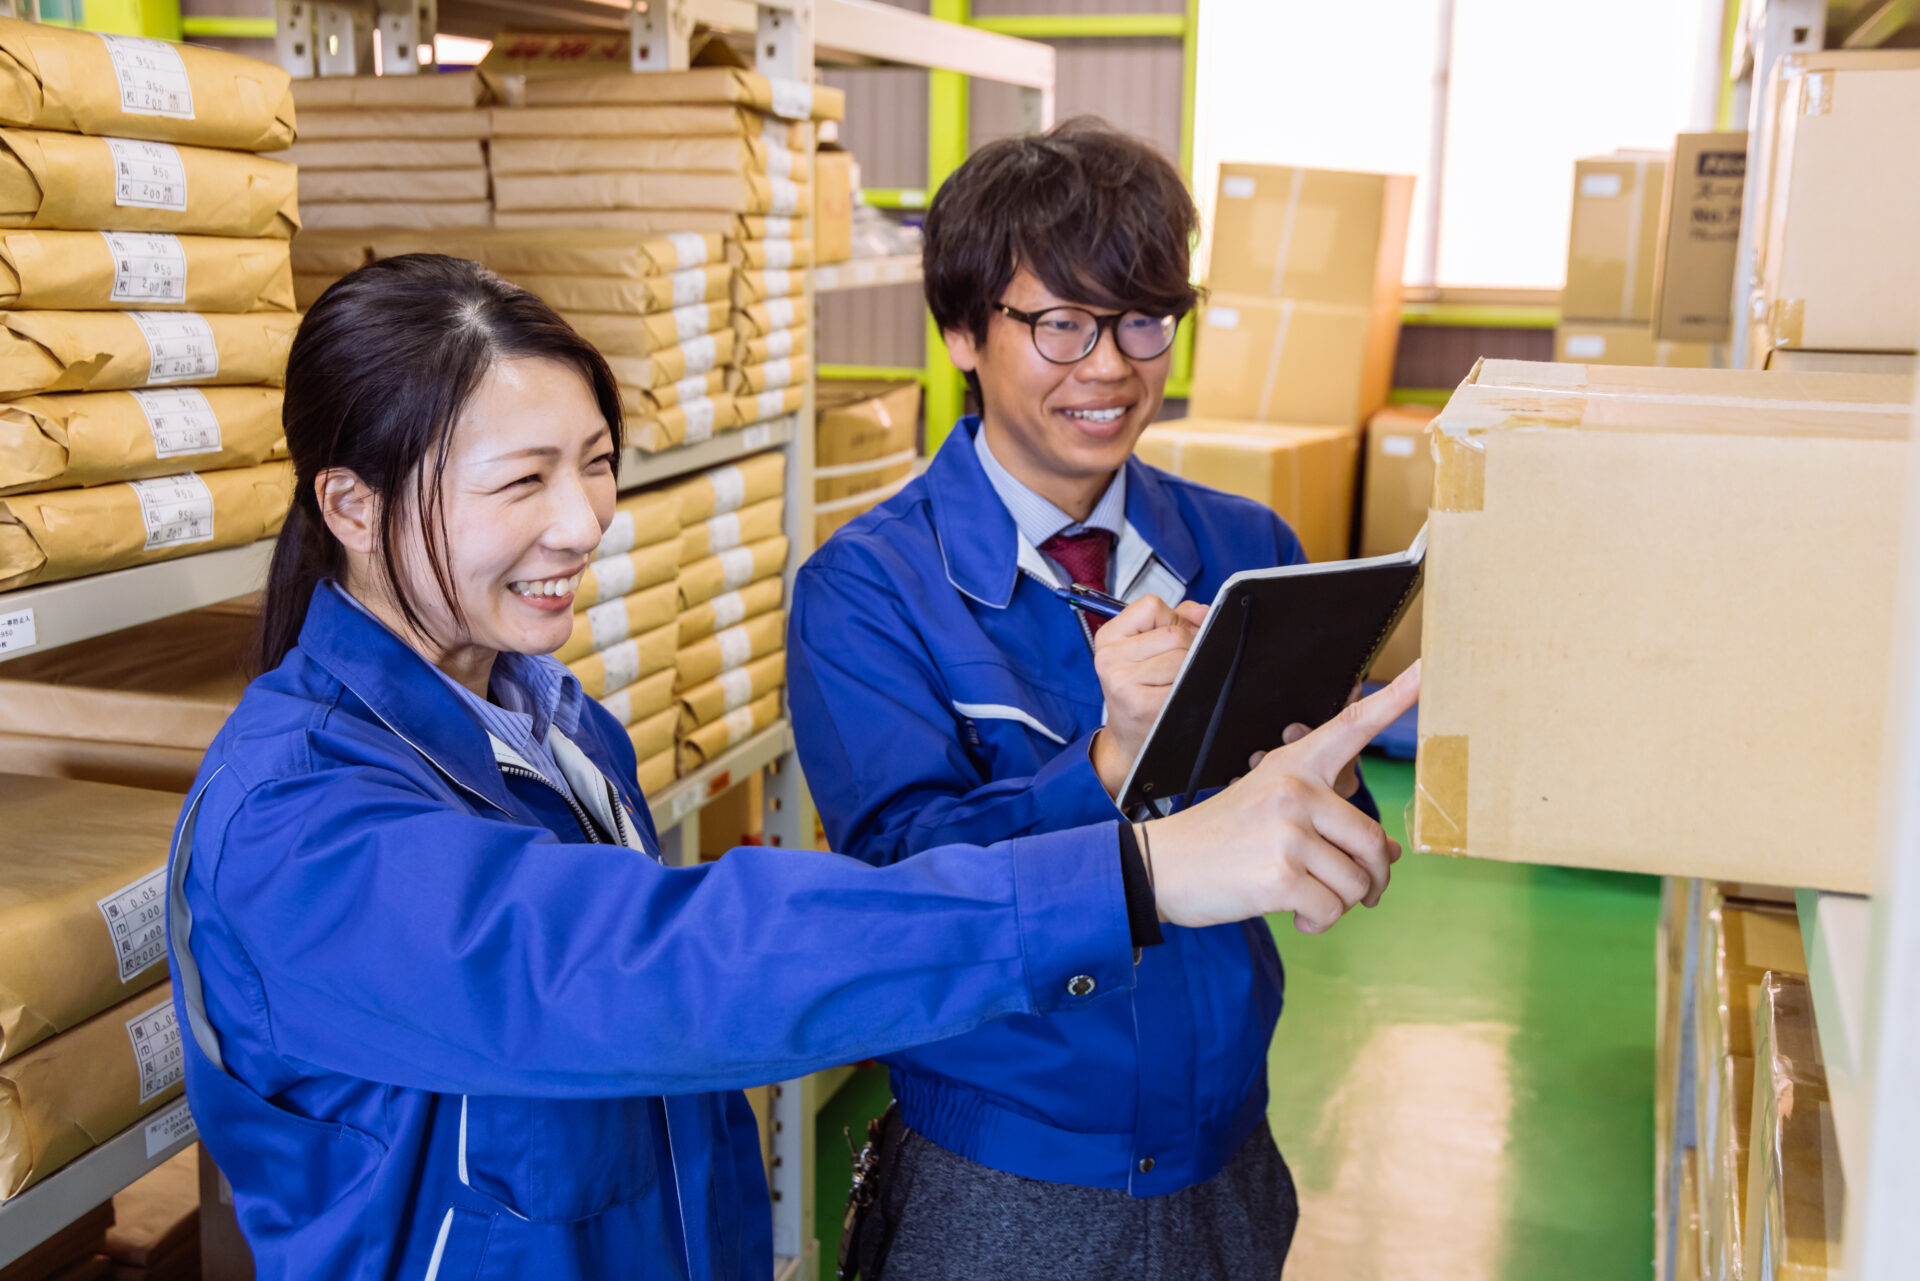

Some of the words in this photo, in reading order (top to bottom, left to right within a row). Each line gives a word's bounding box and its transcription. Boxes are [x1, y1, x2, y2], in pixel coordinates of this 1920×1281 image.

[144, 93, 162, 111] 200
[152, 164, 169, 180] 950
[121, 183, 130, 196] 枚
[143, 183, 161, 199] 200
[153, 262, 172, 276] 950
[119, 280, 128, 293] 枚
[142, 277, 160, 293] 200
[174, 360, 193, 374] 200
[166, 526, 183, 539] 200
[107, 902, 120, 918] 厚
[129, 886, 158, 909] 0.05
[140, 904, 161, 923] 300
[121, 940, 132, 955] 長
[142, 924, 163, 942] 400
[124, 958, 135, 972] 枚
[133, 941, 162, 967] 2000
[134, 1025, 145, 1040] 厚
[163, 1026, 181, 1045] 300
[145, 1060, 155, 1076] 長
[163, 1045, 181, 1064] 400
[145, 1079, 155, 1093] 枚
[155, 1066, 181, 1090] 2000
